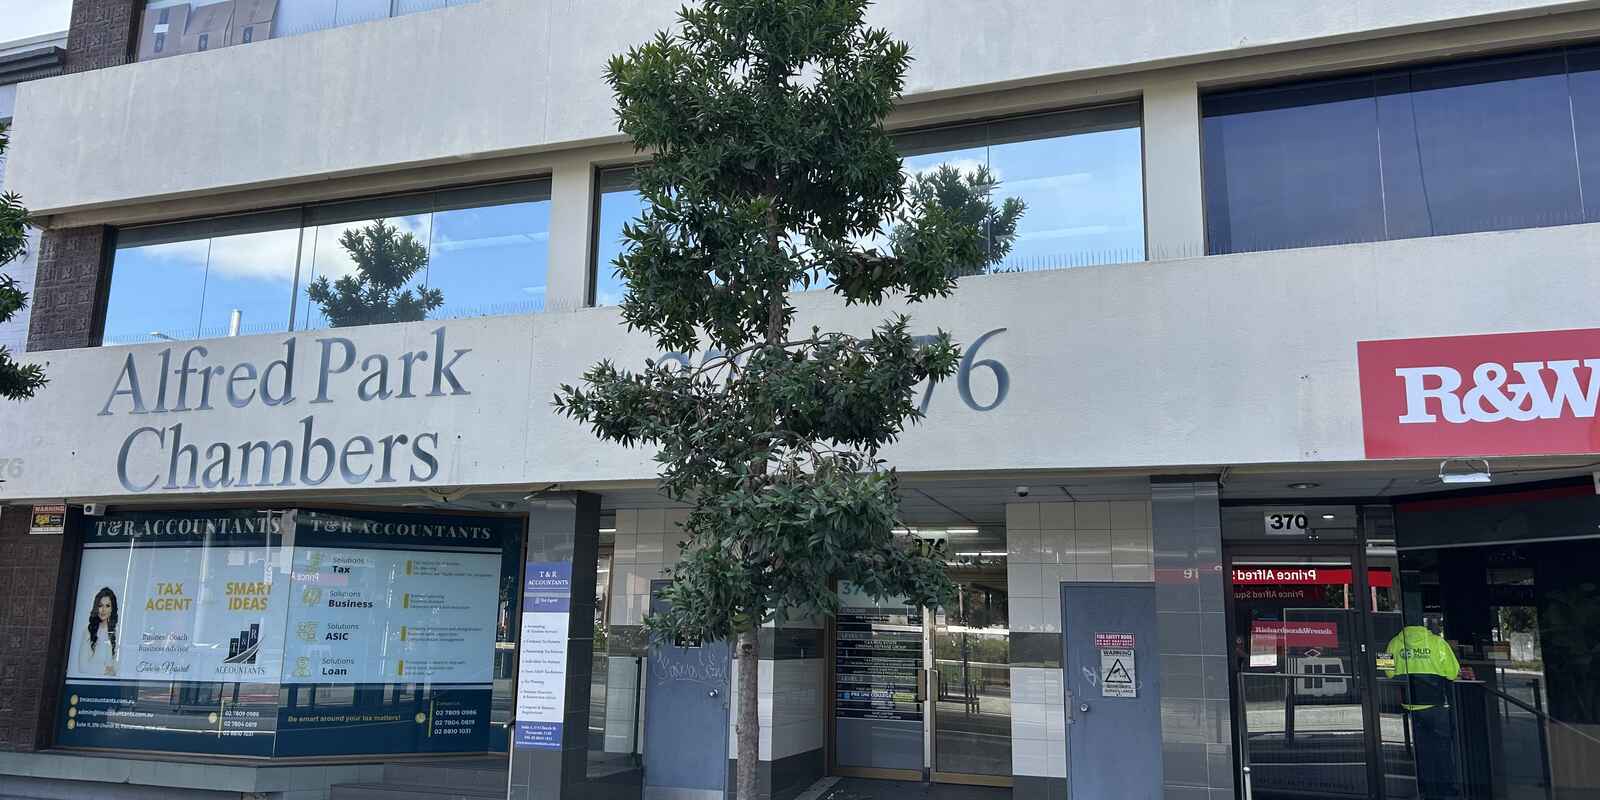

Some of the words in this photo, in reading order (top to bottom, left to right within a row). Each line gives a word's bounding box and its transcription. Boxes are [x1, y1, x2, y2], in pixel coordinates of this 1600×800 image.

[97, 337, 296, 416] Alfred
[309, 326, 473, 404] Park
[1395, 358, 1600, 424] R&W
[117, 416, 439, 492] Chambers
[142, 516, 281, 536] ACCOUNTANTS
[1270, 514, 1308, 530] 370
[357, 522, 492, 540] ACCOUNTANTS
[333, 557, 364, 565] Solutions
[332, 565, 350, 574] Tax
[156, 582, 184, 595] TAX
[225, 582, 273, 595] SMART
[329, 590, 361, 598] Solutions
[145, 598, 192, 611] AGENT
[228, 598, 269, 611] IDEAS
[328, 599, 374, 608] Business
[325, 632, 349, 641] ASIC
[322, 657, 355, 665] Solutions
[216, 665, 265, 675] ACCOUNTANTS
[322, 667, 347, 676] Loan
[344, 715, 361, 724] your
[374, 714, 400, 722] matters!
